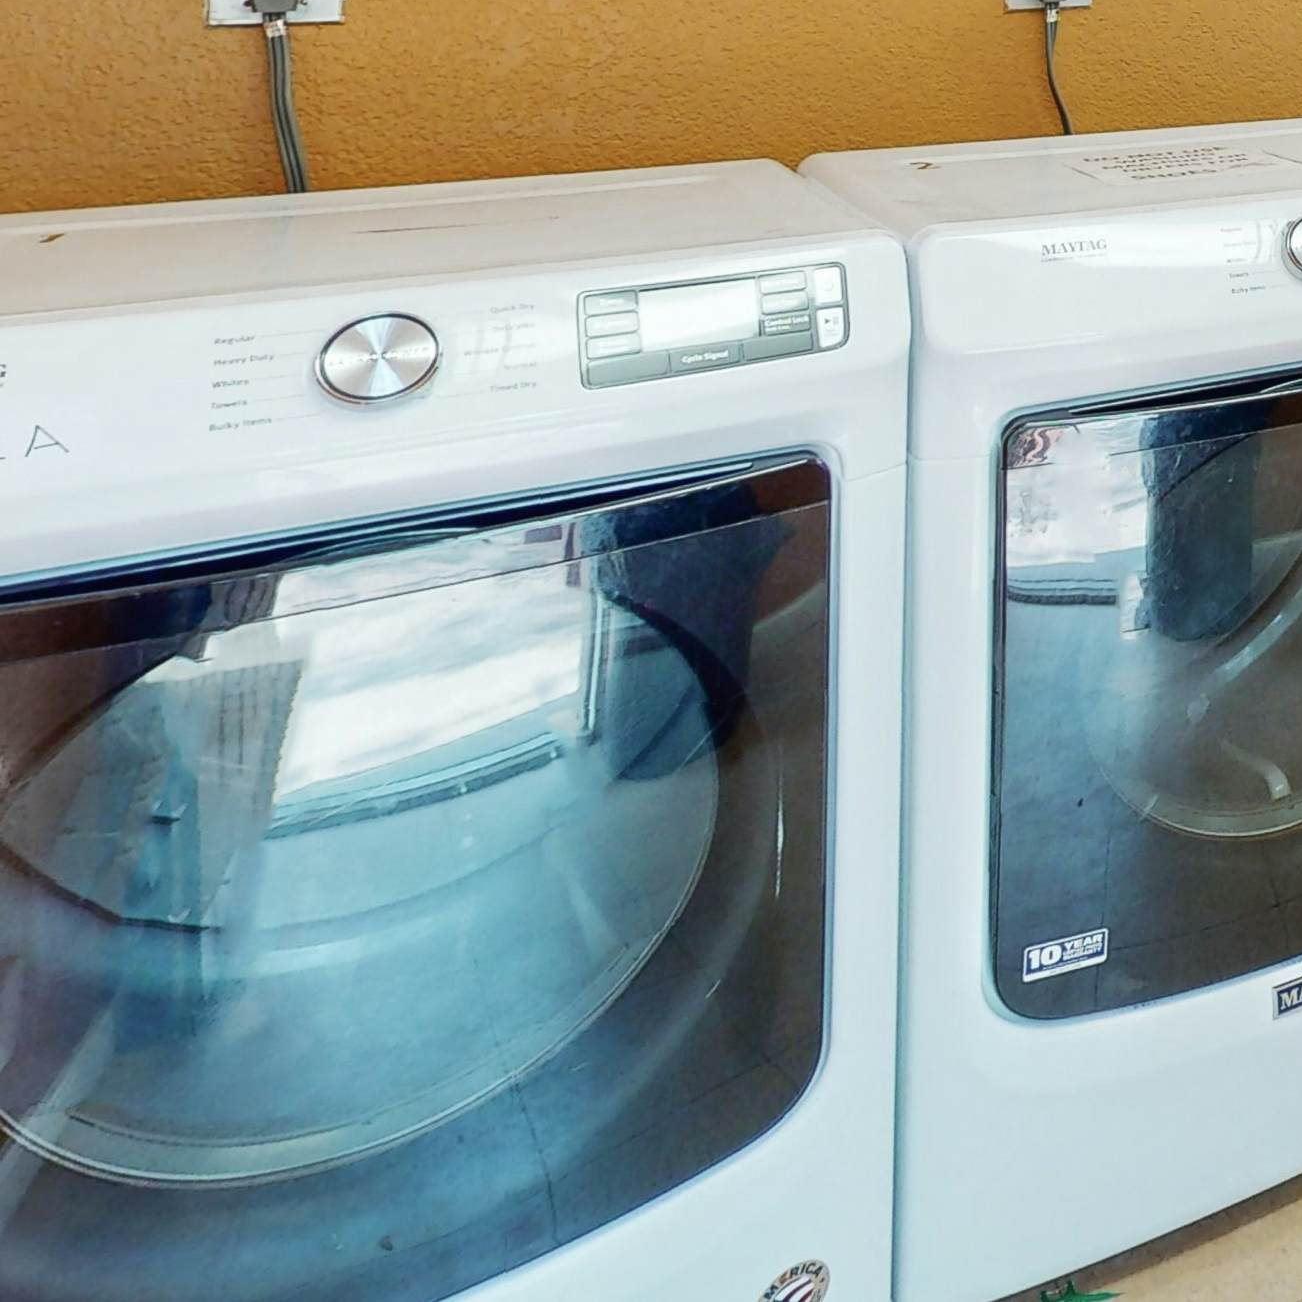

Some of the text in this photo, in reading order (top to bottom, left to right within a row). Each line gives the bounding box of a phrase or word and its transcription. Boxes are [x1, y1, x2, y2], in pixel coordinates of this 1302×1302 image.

[1042, 239, 1107, 256] MAYTAG
[214, 334, 255, 345] Regular
[214, 354, 275, 367] Heavy Duty
[703, 349, 728, 362] Signal
[212, 379, 249, 389] Whites
[1028, 944, 1062, 970] 10
[1063, 933, 1104, 950] YEAR
[762, 1261, 825, 1301] MERICA
